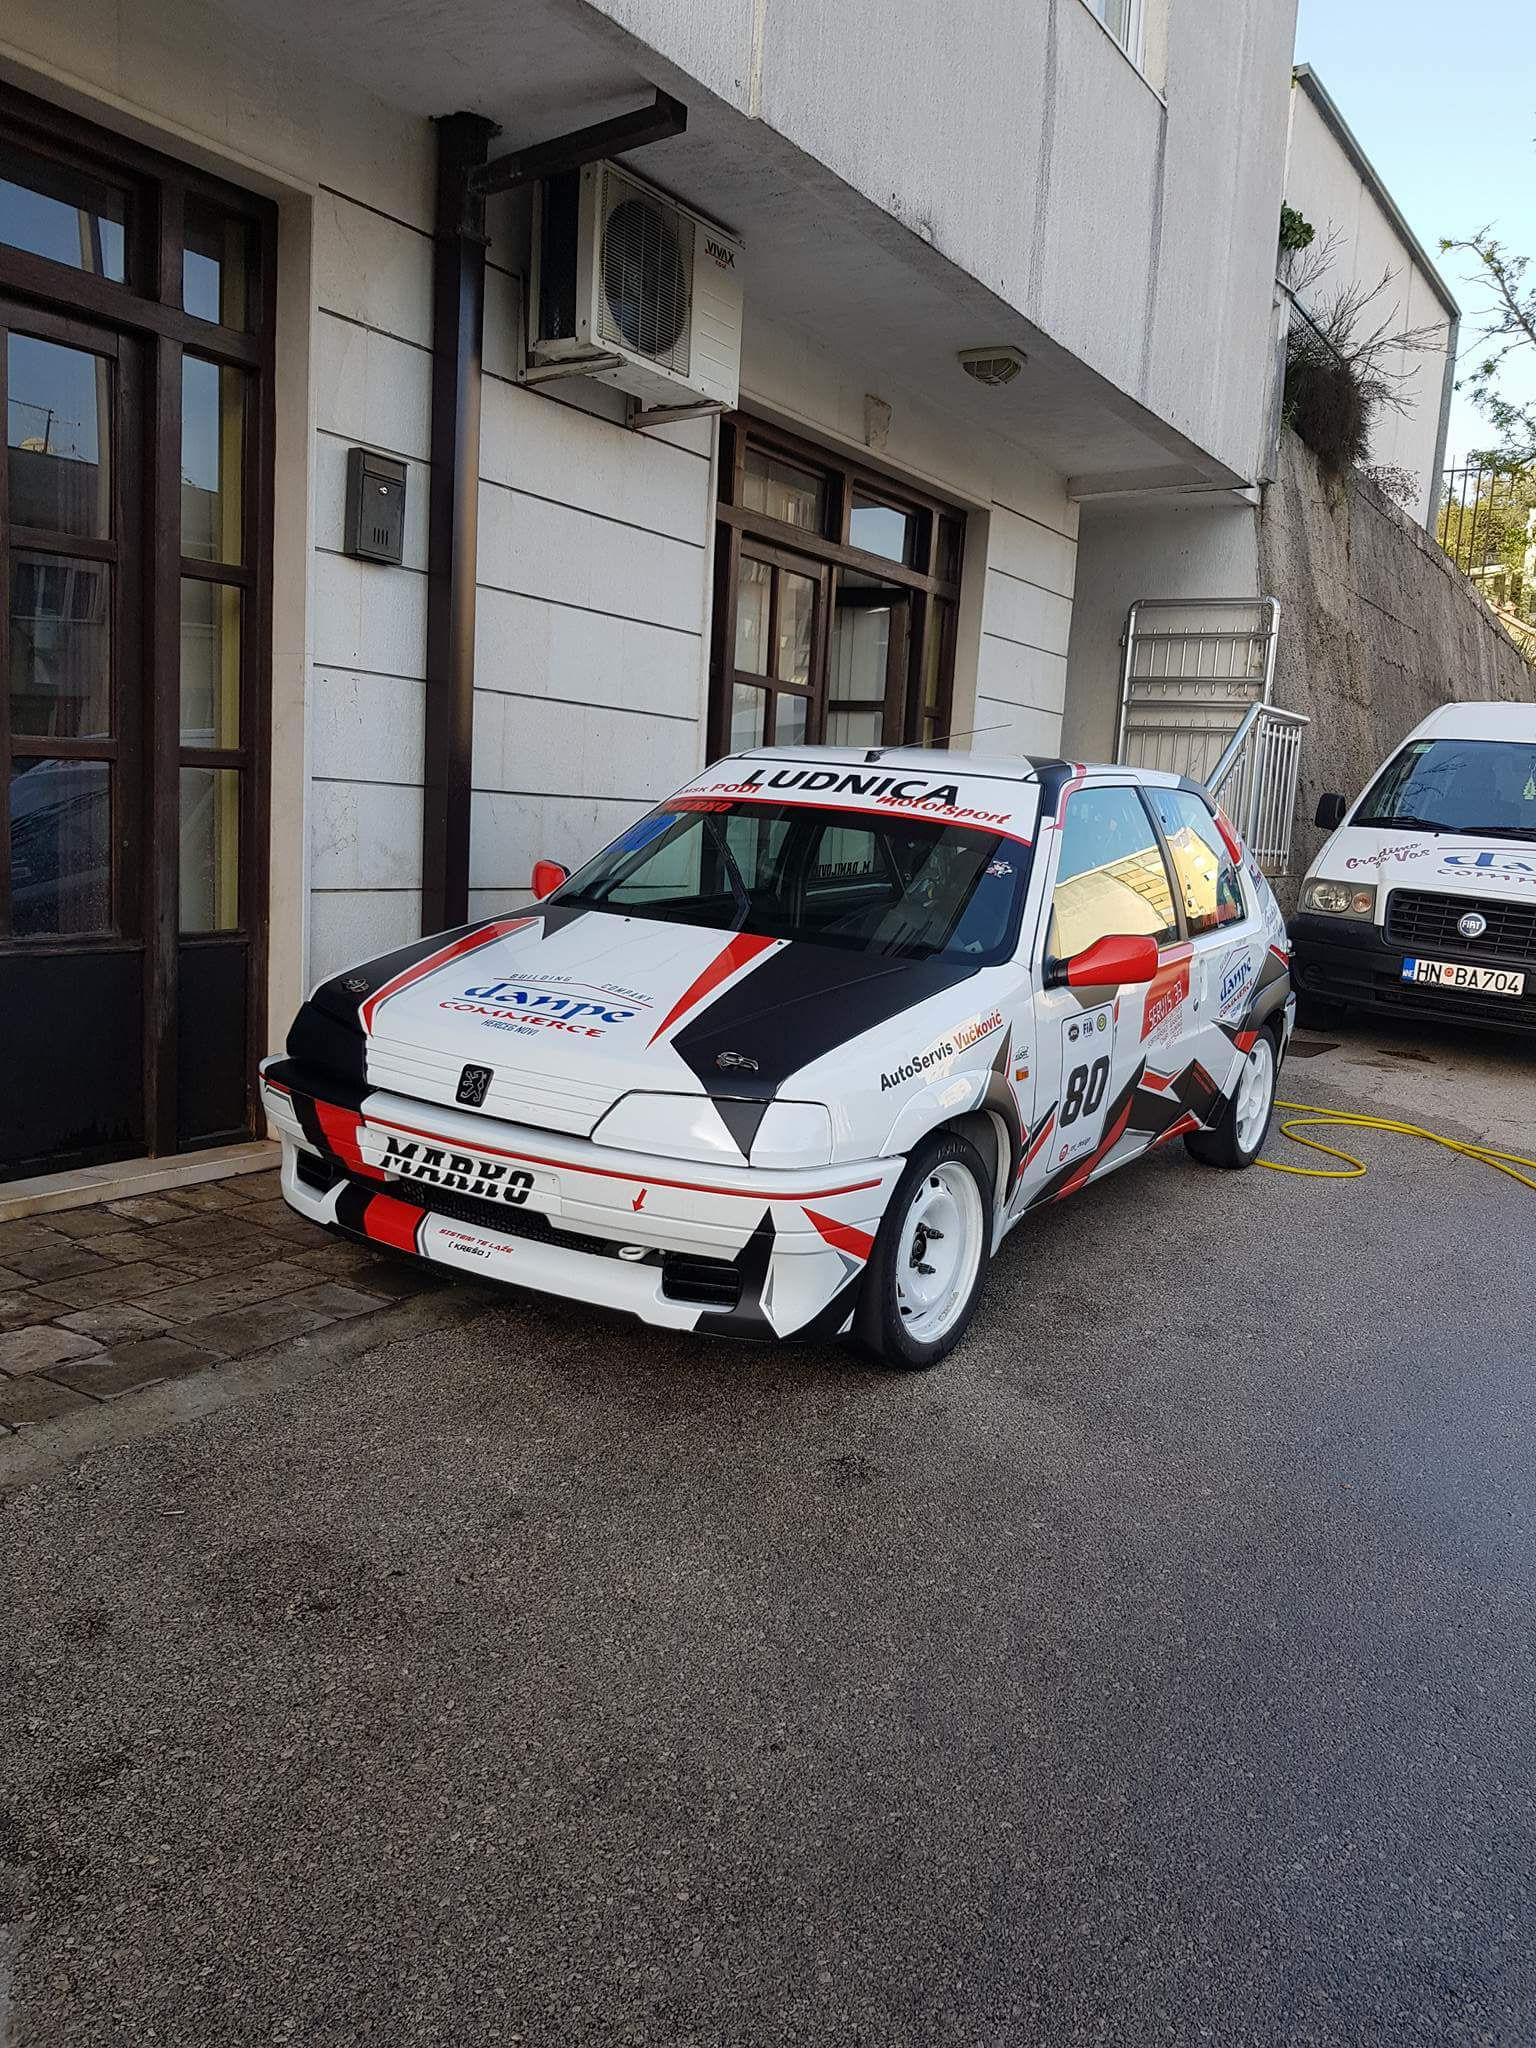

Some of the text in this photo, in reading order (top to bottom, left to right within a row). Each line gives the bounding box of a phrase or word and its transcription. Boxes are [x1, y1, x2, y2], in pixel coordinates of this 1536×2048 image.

[706, 239, 735, 268] VIVAX
[741, 769, 960, 806] LUDNICA
[875, 795, 1014, 825] motorsport
[1461, 919, 1482, 930] FIAT
[509, 973, 572, 982] BUILDING
[600, 983, 654, 1002] COMPANY
[1417, 962, 1519, 993] HN BA704
[464, 982, 635, 1023] danpe
[439, 1001, 607, 1038] COMMERCE
[481, 1019, 539, 1036] HERCEG NOVI
[880, 1009, 1003, 1092] AutoServis Vučković
[1059, 1055, 1110, 1129] 80
[380, 1136, 535, 1205] MARKO
